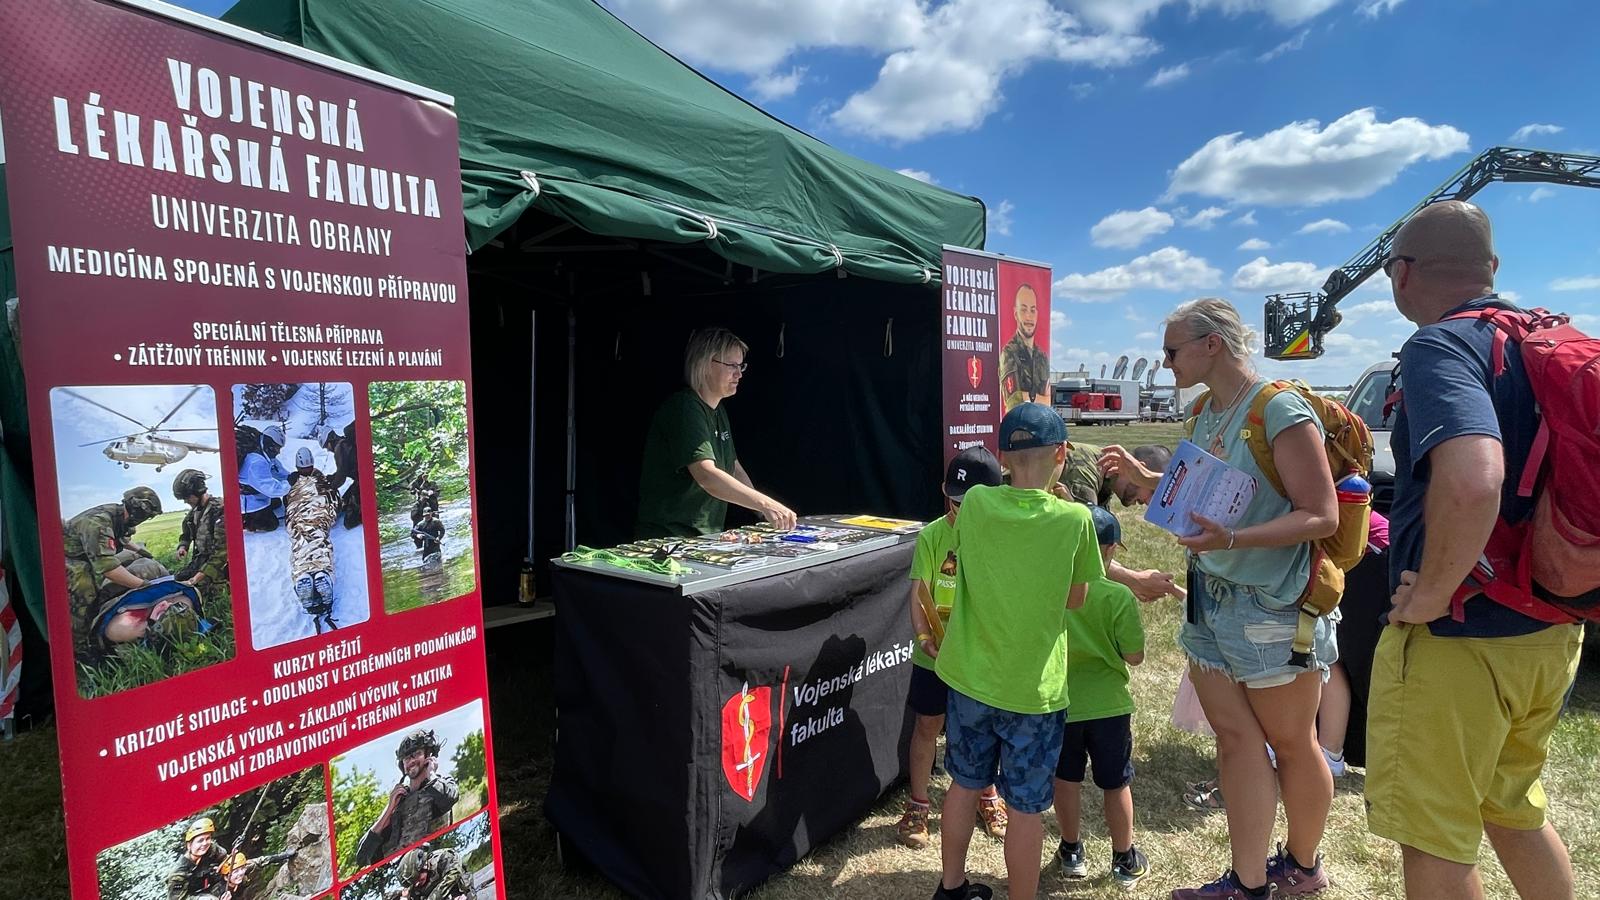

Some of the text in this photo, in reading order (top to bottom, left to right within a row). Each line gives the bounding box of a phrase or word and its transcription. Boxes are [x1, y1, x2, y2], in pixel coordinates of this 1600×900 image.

[167, 58, 364, 152] VOJENSKÁ
[53, 93, 441, 218] LÉKAŘSKÁ FAKULTA
[151, 194, 392, 257] UNIVERZITA OBRANY
[47, 245, 457, 304] MEDICÍNA SPOJENÁ S VOJENSKOU PŘÍPRAVOU
[946, 265, 995, 290] VOJENSKÁ
[946, 286, 996, 315] LÉKAŘSKÁ
[193, 321, 383, 345] SPECIÁLNÍ TĚLESNÁ PŘÍPRAVA
[946, 315, 987, 338] FAKULTA
[946, 340, 975, 351] UNIVERZITA
[128, 343, 442, 367] ZÁTĚŽOVÝ TRÉNINK VOJENSKÉ LEZENÍ A PLAVÁNÍ
[957, 468, 967, 482] R
[936, 578, 957, 590] PASS
[273, 635, 361, 679] KURZY PŘEŽITÍ
[793, 640, 914, 708] Vojenská lékařsk
[114, 625, 477, 757] KRIZOVÉ SITUACE ODOLNOST V EXTRÉMNÍCH PODMÍNKÁCH
[157, 663, 453, 782] VOJENSKÁ VÝUKA ZÁKLADNÍ VÝCVIK TAKTIKA
[203, 688, 438, 791] POLNÍ ZDRAVOTNICTVÍ TERÉNNÍ KURZY
[790, 705, 845, 747] fakulta
